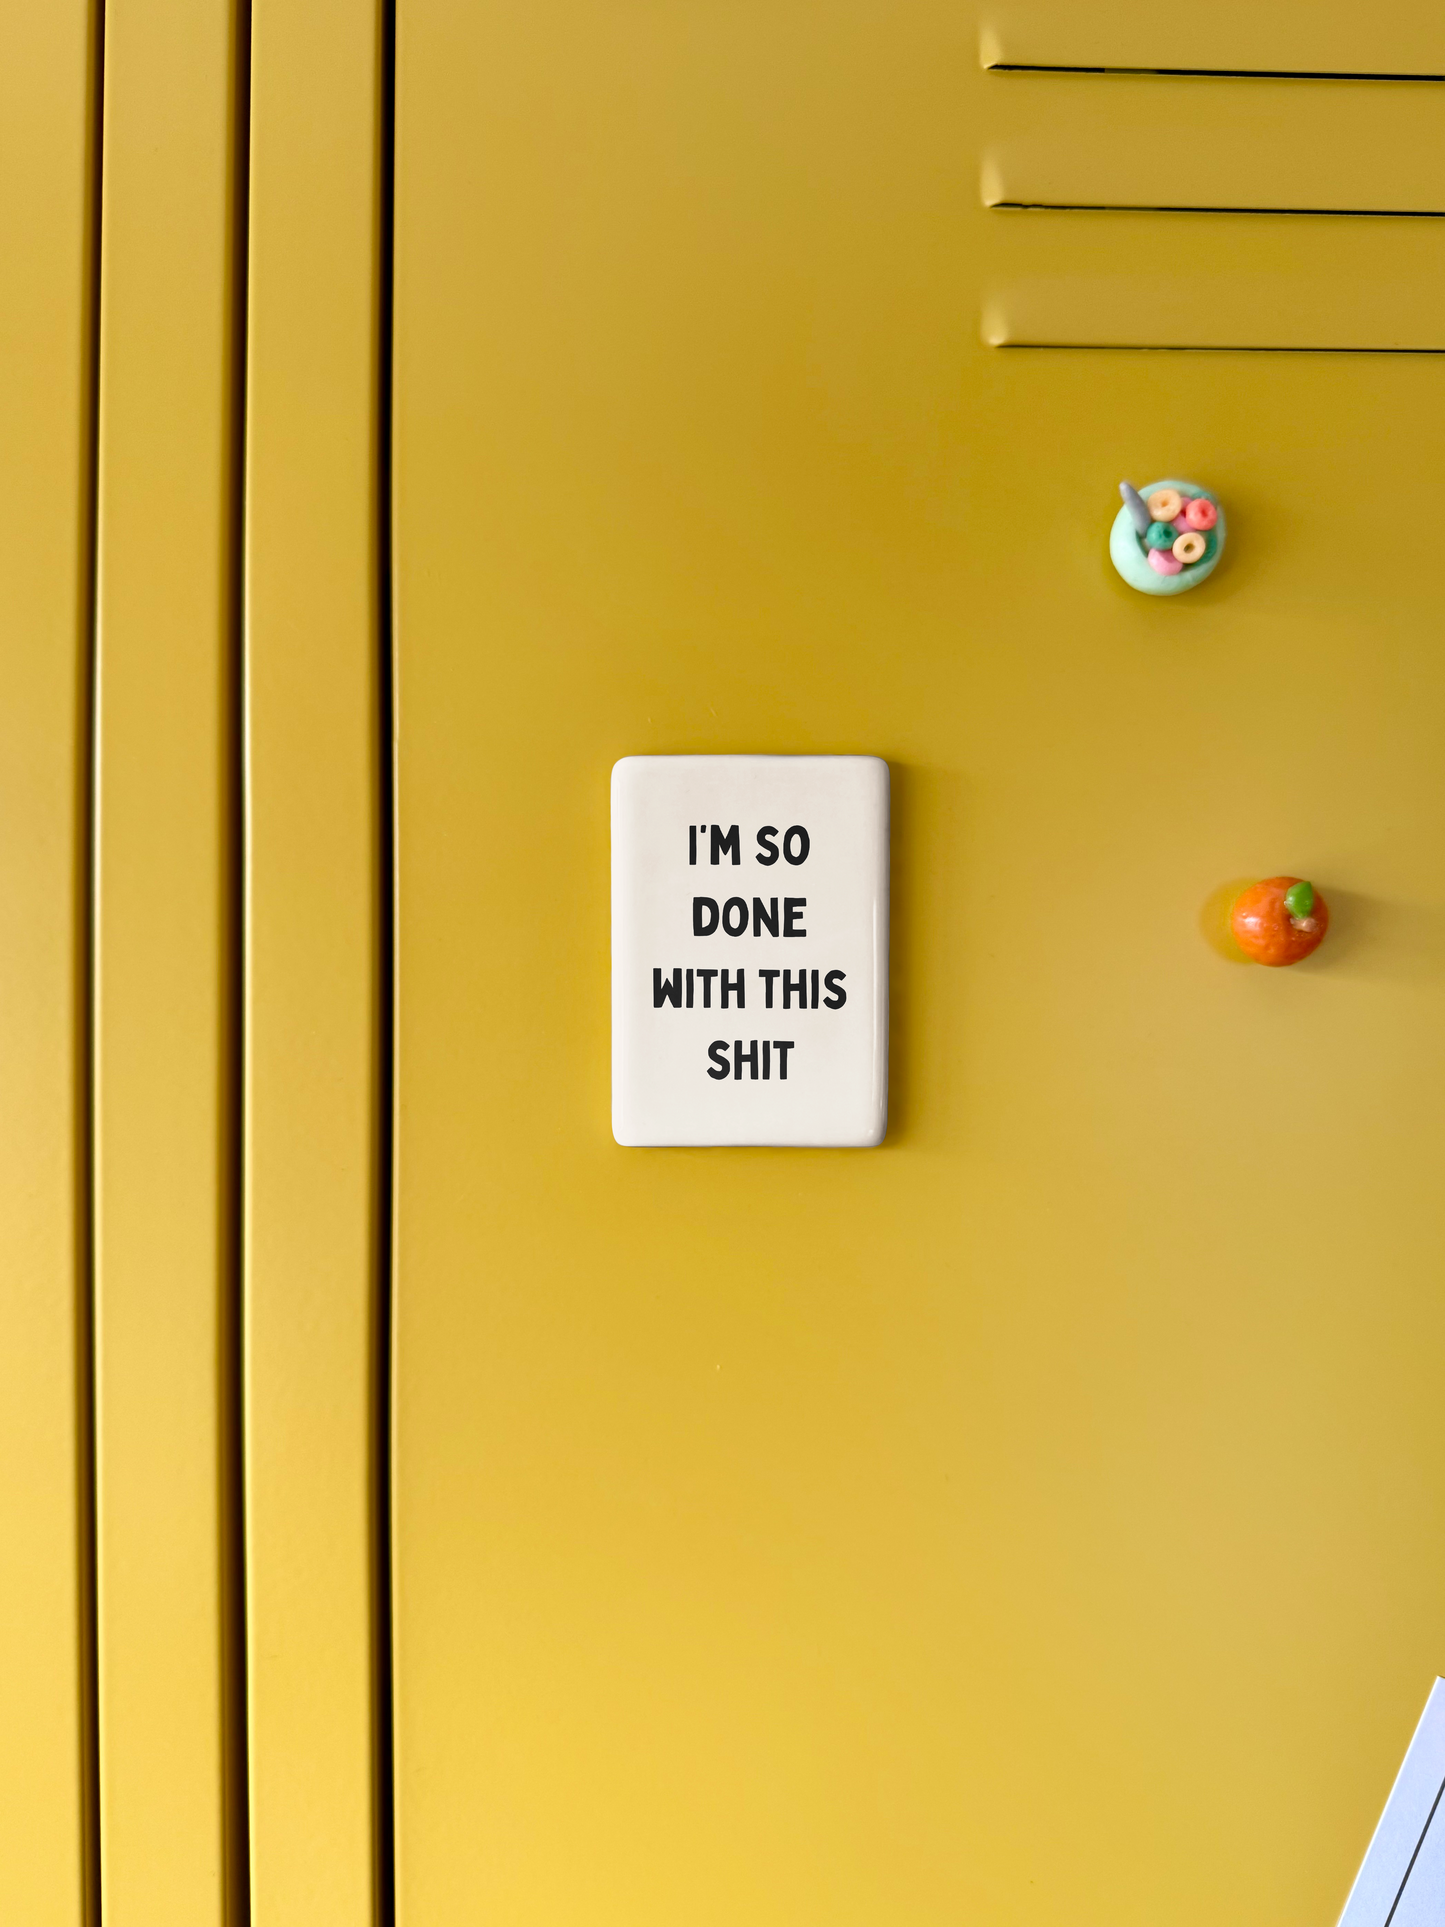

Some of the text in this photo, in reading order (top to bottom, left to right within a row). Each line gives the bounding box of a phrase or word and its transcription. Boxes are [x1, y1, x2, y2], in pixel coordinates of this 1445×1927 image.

[689, 825, 811, 866] I'M SO
[692, 896, 807, 938] DONE
[652, 967, 847, 1010] WITH THIS
[706, 1040, 795, 1081] SHIT
